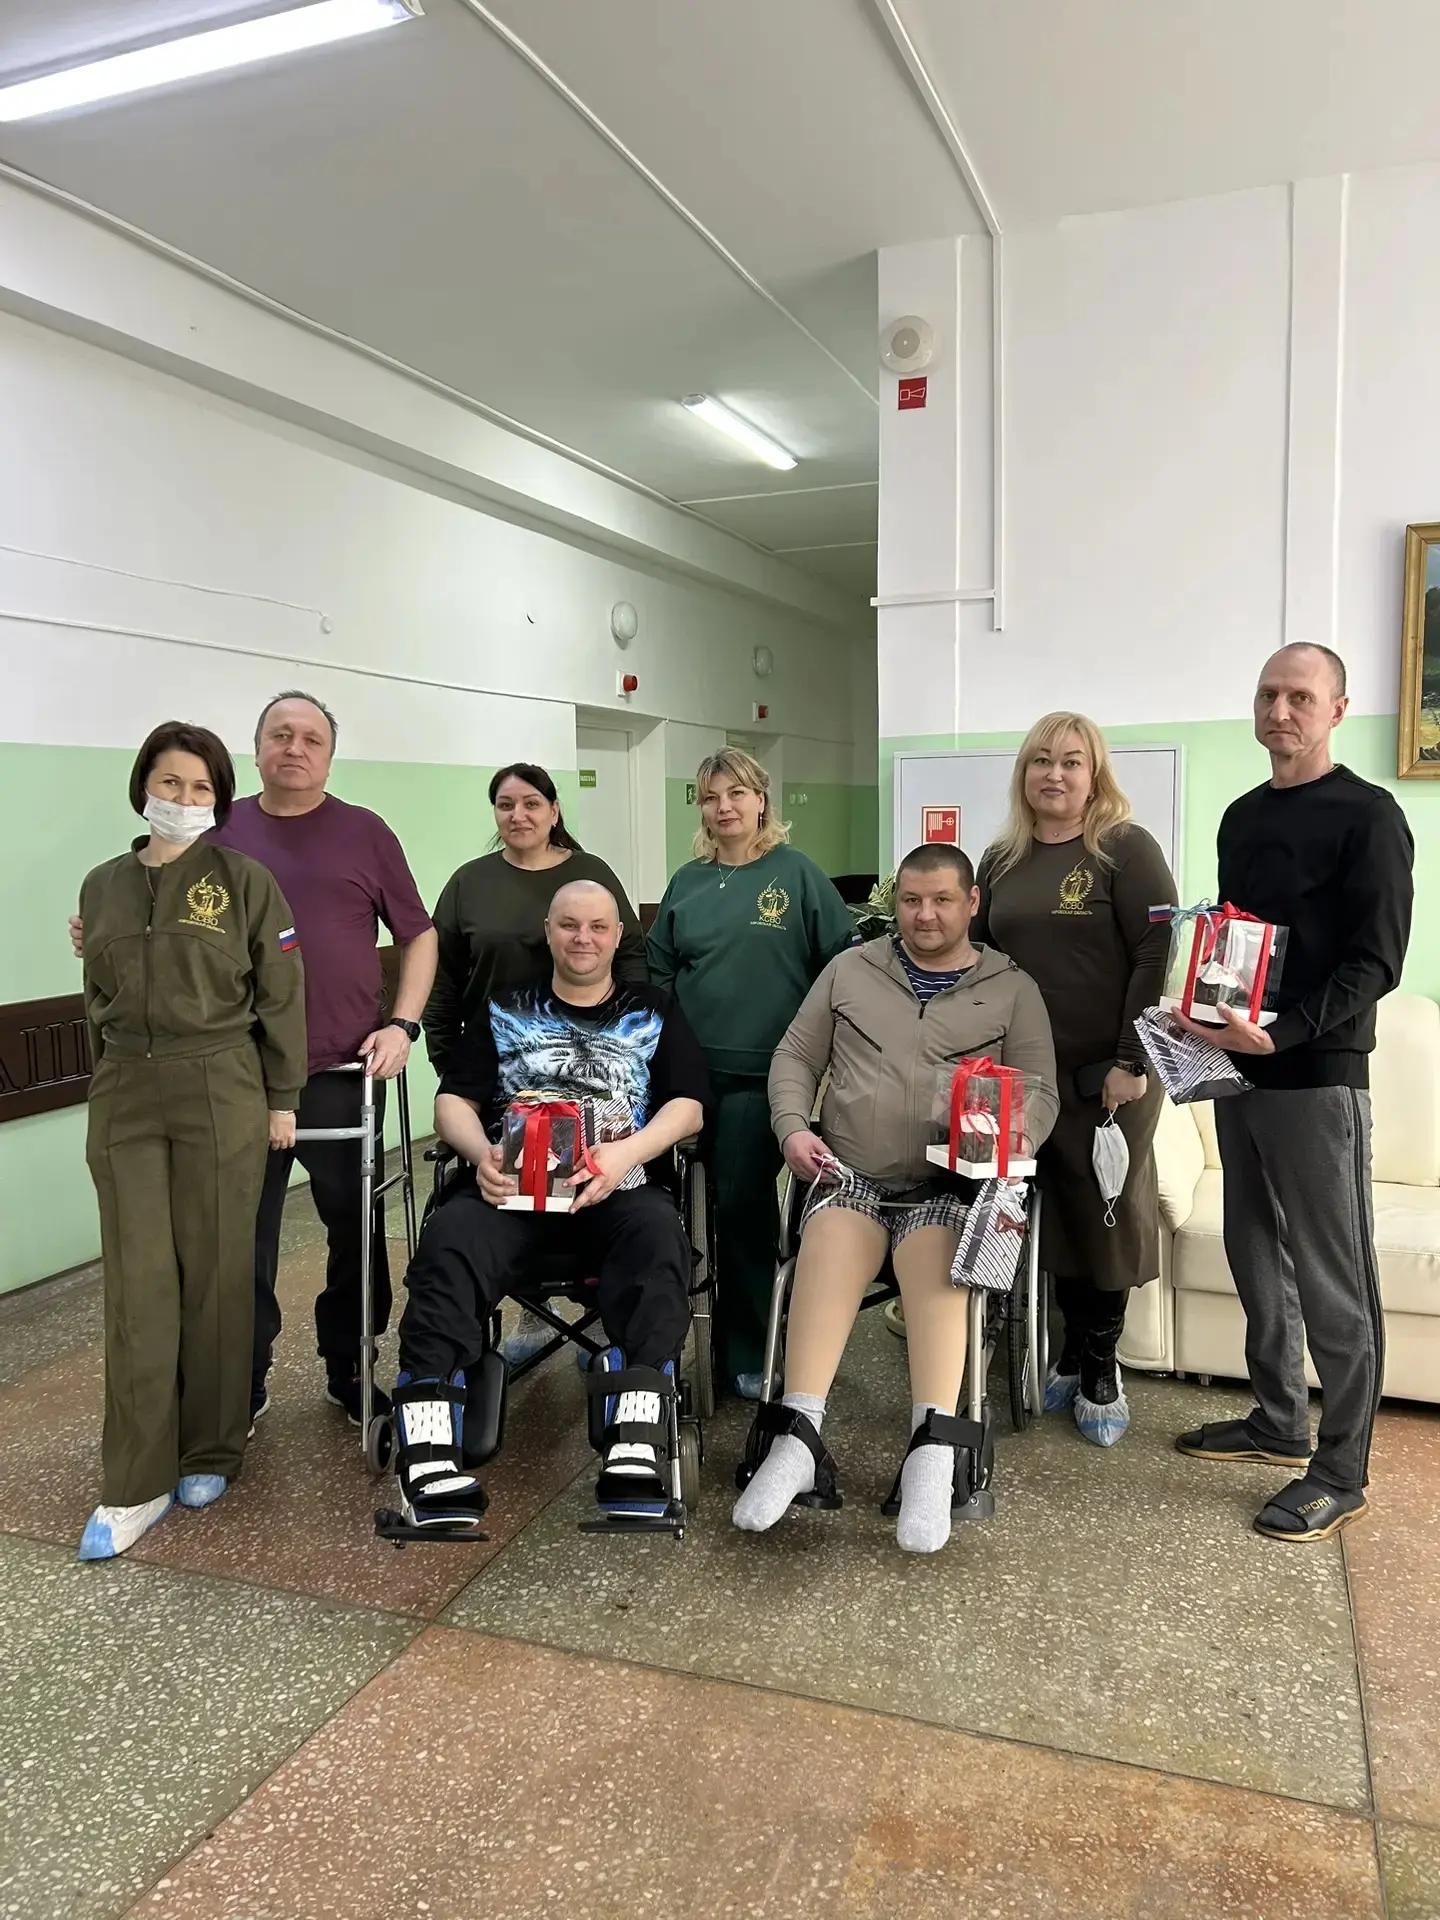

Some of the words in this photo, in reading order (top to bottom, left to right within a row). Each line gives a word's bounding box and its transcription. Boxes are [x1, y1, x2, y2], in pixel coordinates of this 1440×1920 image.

[1060, 901, 1084, 910] КСВО
[190, 912, 219, 926] КСВО
[759, 914, 782, 925] КСВО
[1296, 1496, 1331, 1515] SPORT
